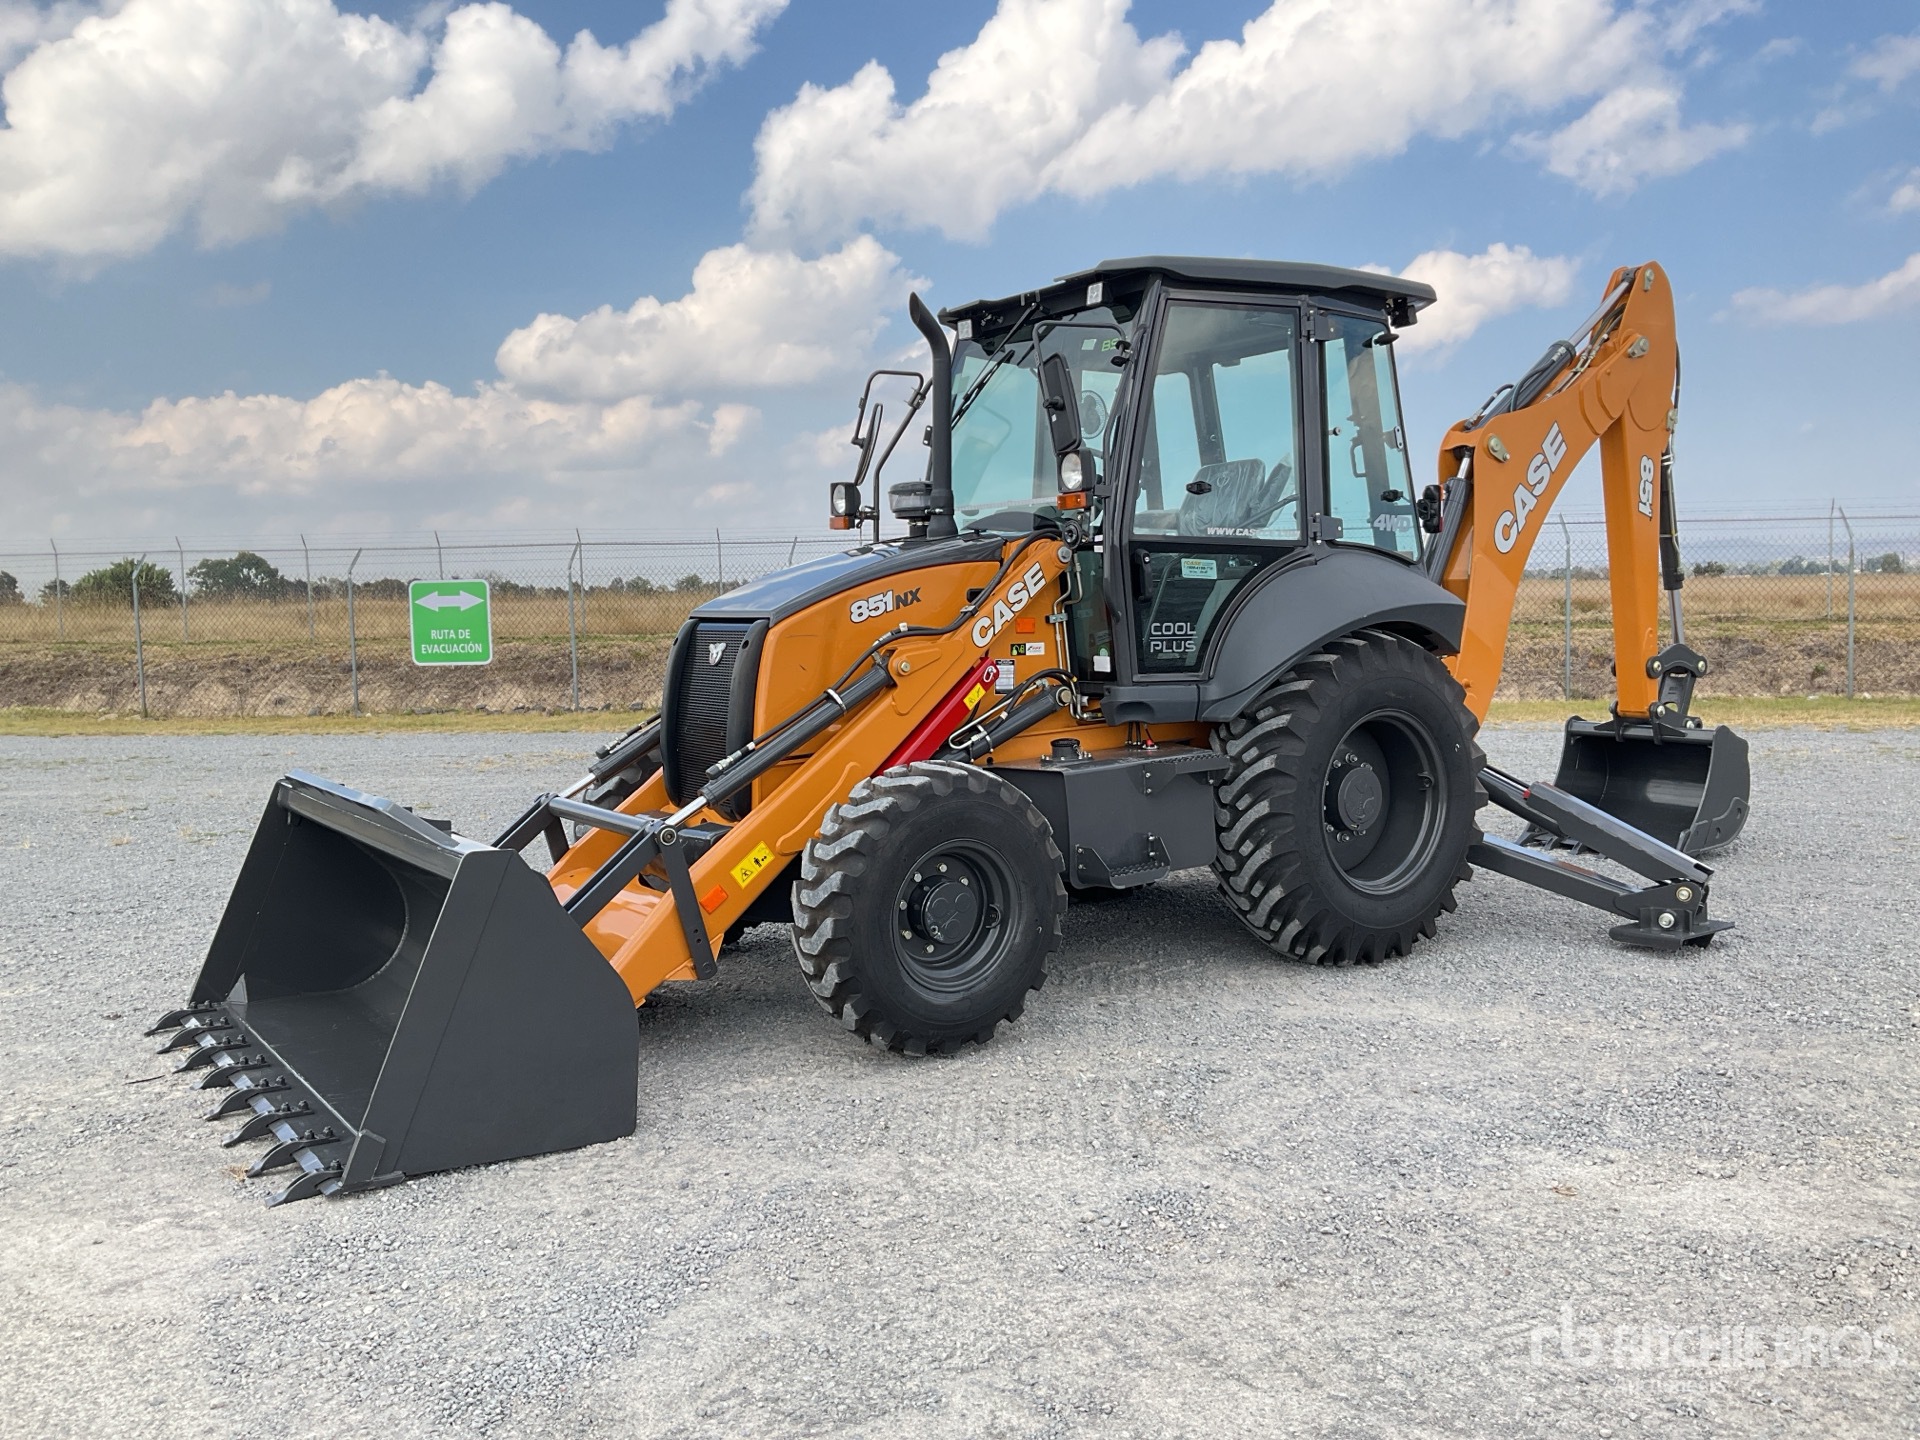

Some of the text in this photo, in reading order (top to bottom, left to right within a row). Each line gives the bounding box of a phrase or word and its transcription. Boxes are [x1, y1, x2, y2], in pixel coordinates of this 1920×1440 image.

[1494, 420, 1569, 554] CASE
[1638, 454, 1655, 518] 851
[1373, 513, 1411, 533] 4WD
[971, 561, 1047, 648] CASE
[430, 629, 470, 639] RUTA DE
[1151, 622, 1197, 635] COOL
[421, 642, 482, 653] EVACUACIÓN
[1150, 640, 1196, 653] PLUS
